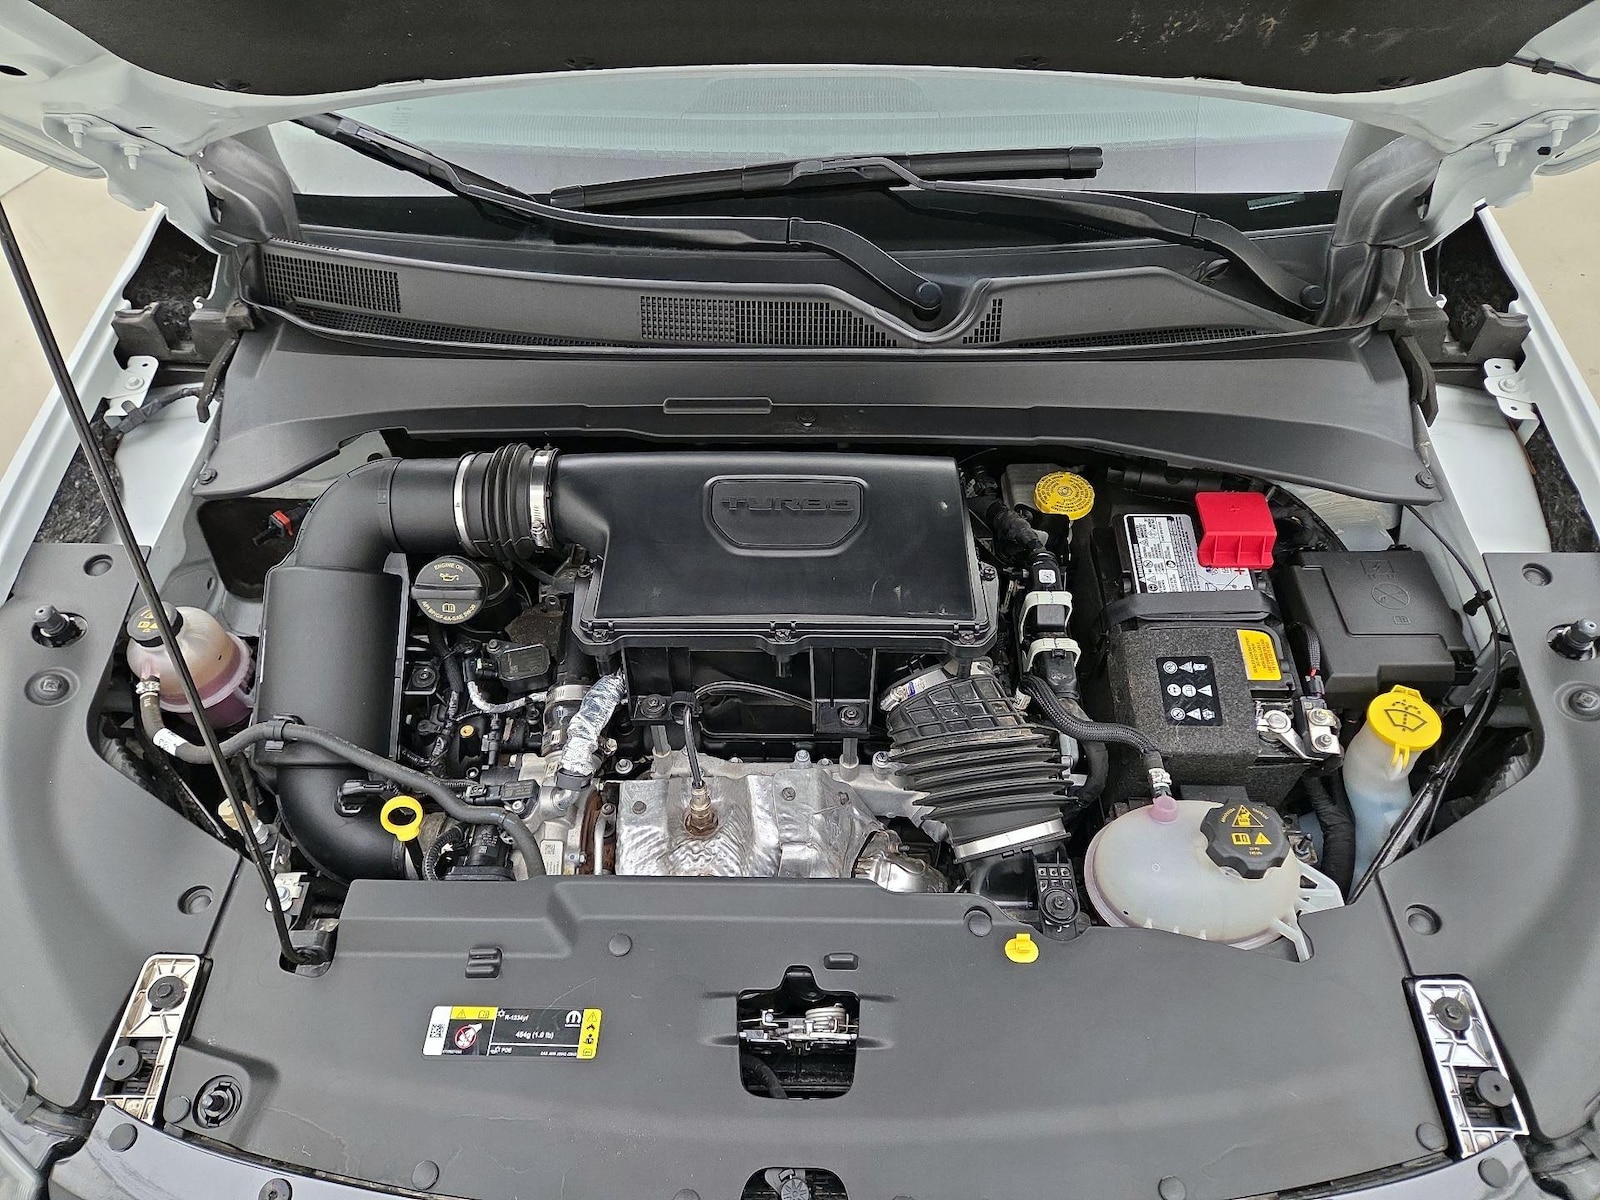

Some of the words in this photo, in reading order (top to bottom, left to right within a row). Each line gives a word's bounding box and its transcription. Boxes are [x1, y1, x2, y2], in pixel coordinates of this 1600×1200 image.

[721, 497, 854, 512] TURBO
[455, 564, 464, 572] OIL
[504, 1014, 529, 1022] R-1234yf
[515, 1030, 532, 1040] 454g
[545, 1031, 555, 1040] lb)
